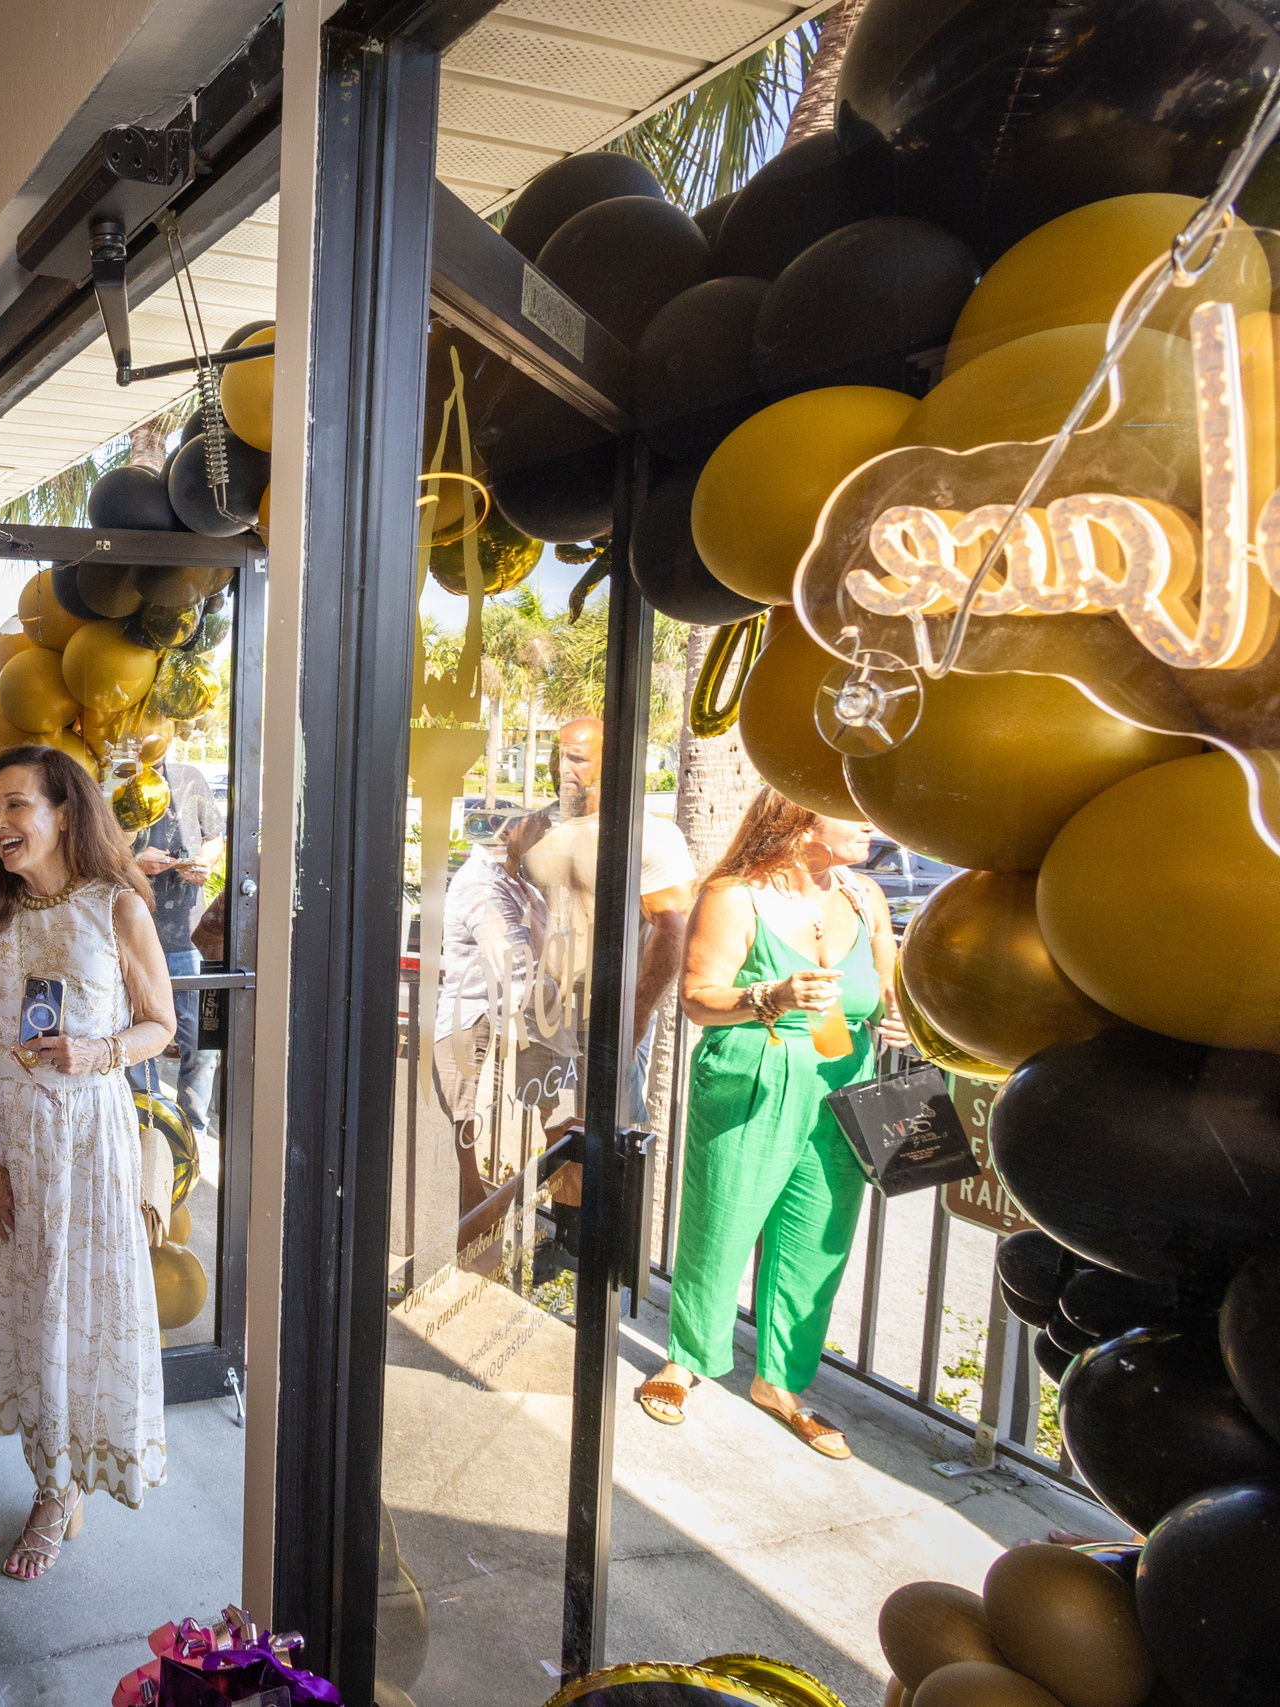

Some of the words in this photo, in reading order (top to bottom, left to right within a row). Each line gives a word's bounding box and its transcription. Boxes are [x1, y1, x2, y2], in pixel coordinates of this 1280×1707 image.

[204, 989, 218, 1018] USH
[507, 1057, 579, 1121] YOGA
[404, 1283, 429, 1314] Our
[429, 1265, 452, 1294] door
[466, 1224, 495, 1265] locked
[437, 1291, 470, 1331] ensure
